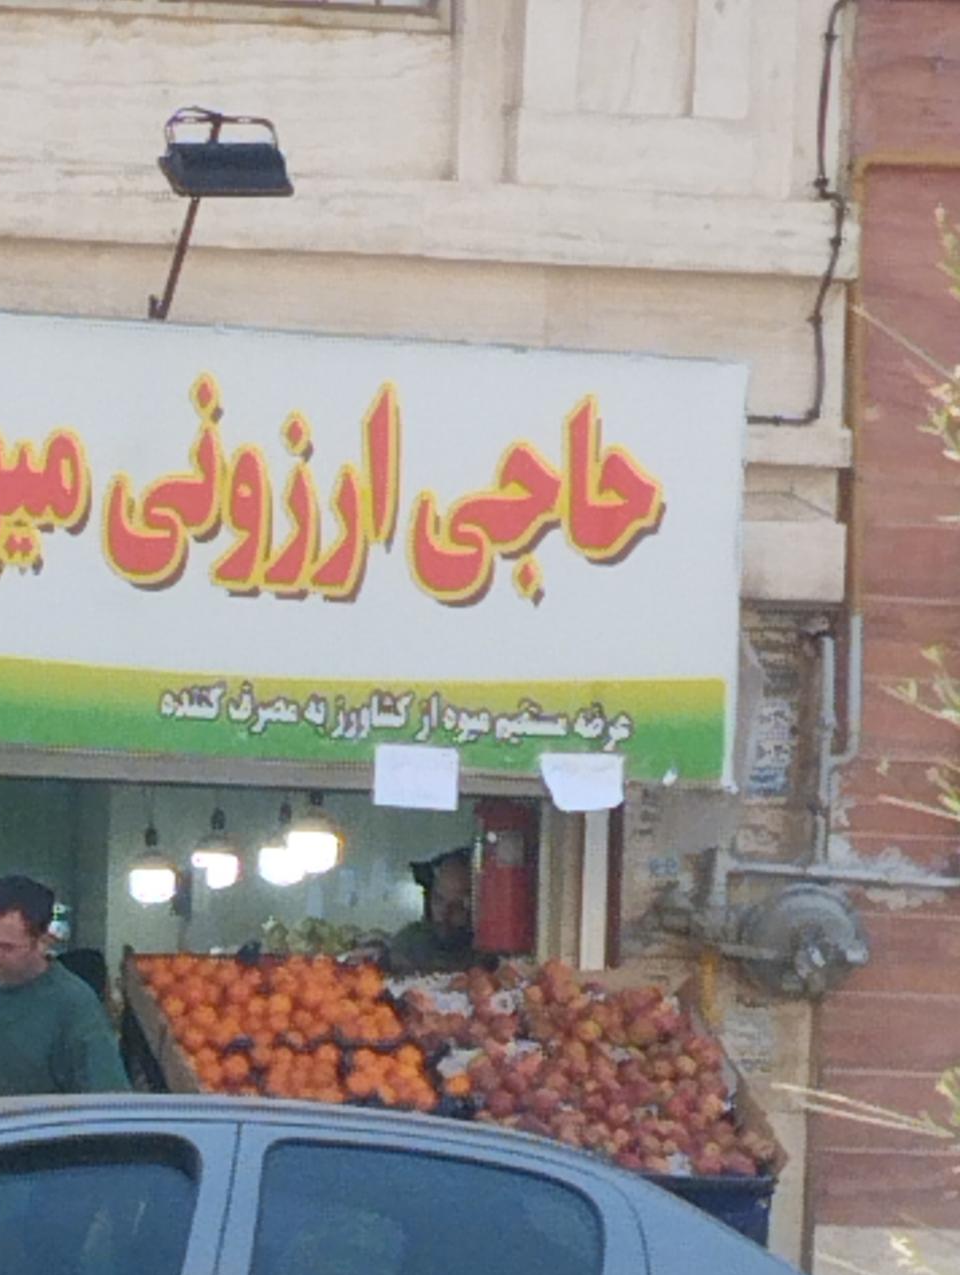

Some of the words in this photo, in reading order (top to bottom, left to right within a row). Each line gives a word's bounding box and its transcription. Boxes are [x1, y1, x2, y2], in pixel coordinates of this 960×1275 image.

[102, 372, 400, 603] ارزونی
[408, 393, 664, 606] حاجی
[159, 679, 228, 722] کننده
[226, 680, 301, 735] مصرف
[328, 688, 416, 740] کشاورز
[414, 690, 441, 742] از
[440, 702, 492, 744] میوه
[493, 696, 570, 746] مستقیم
